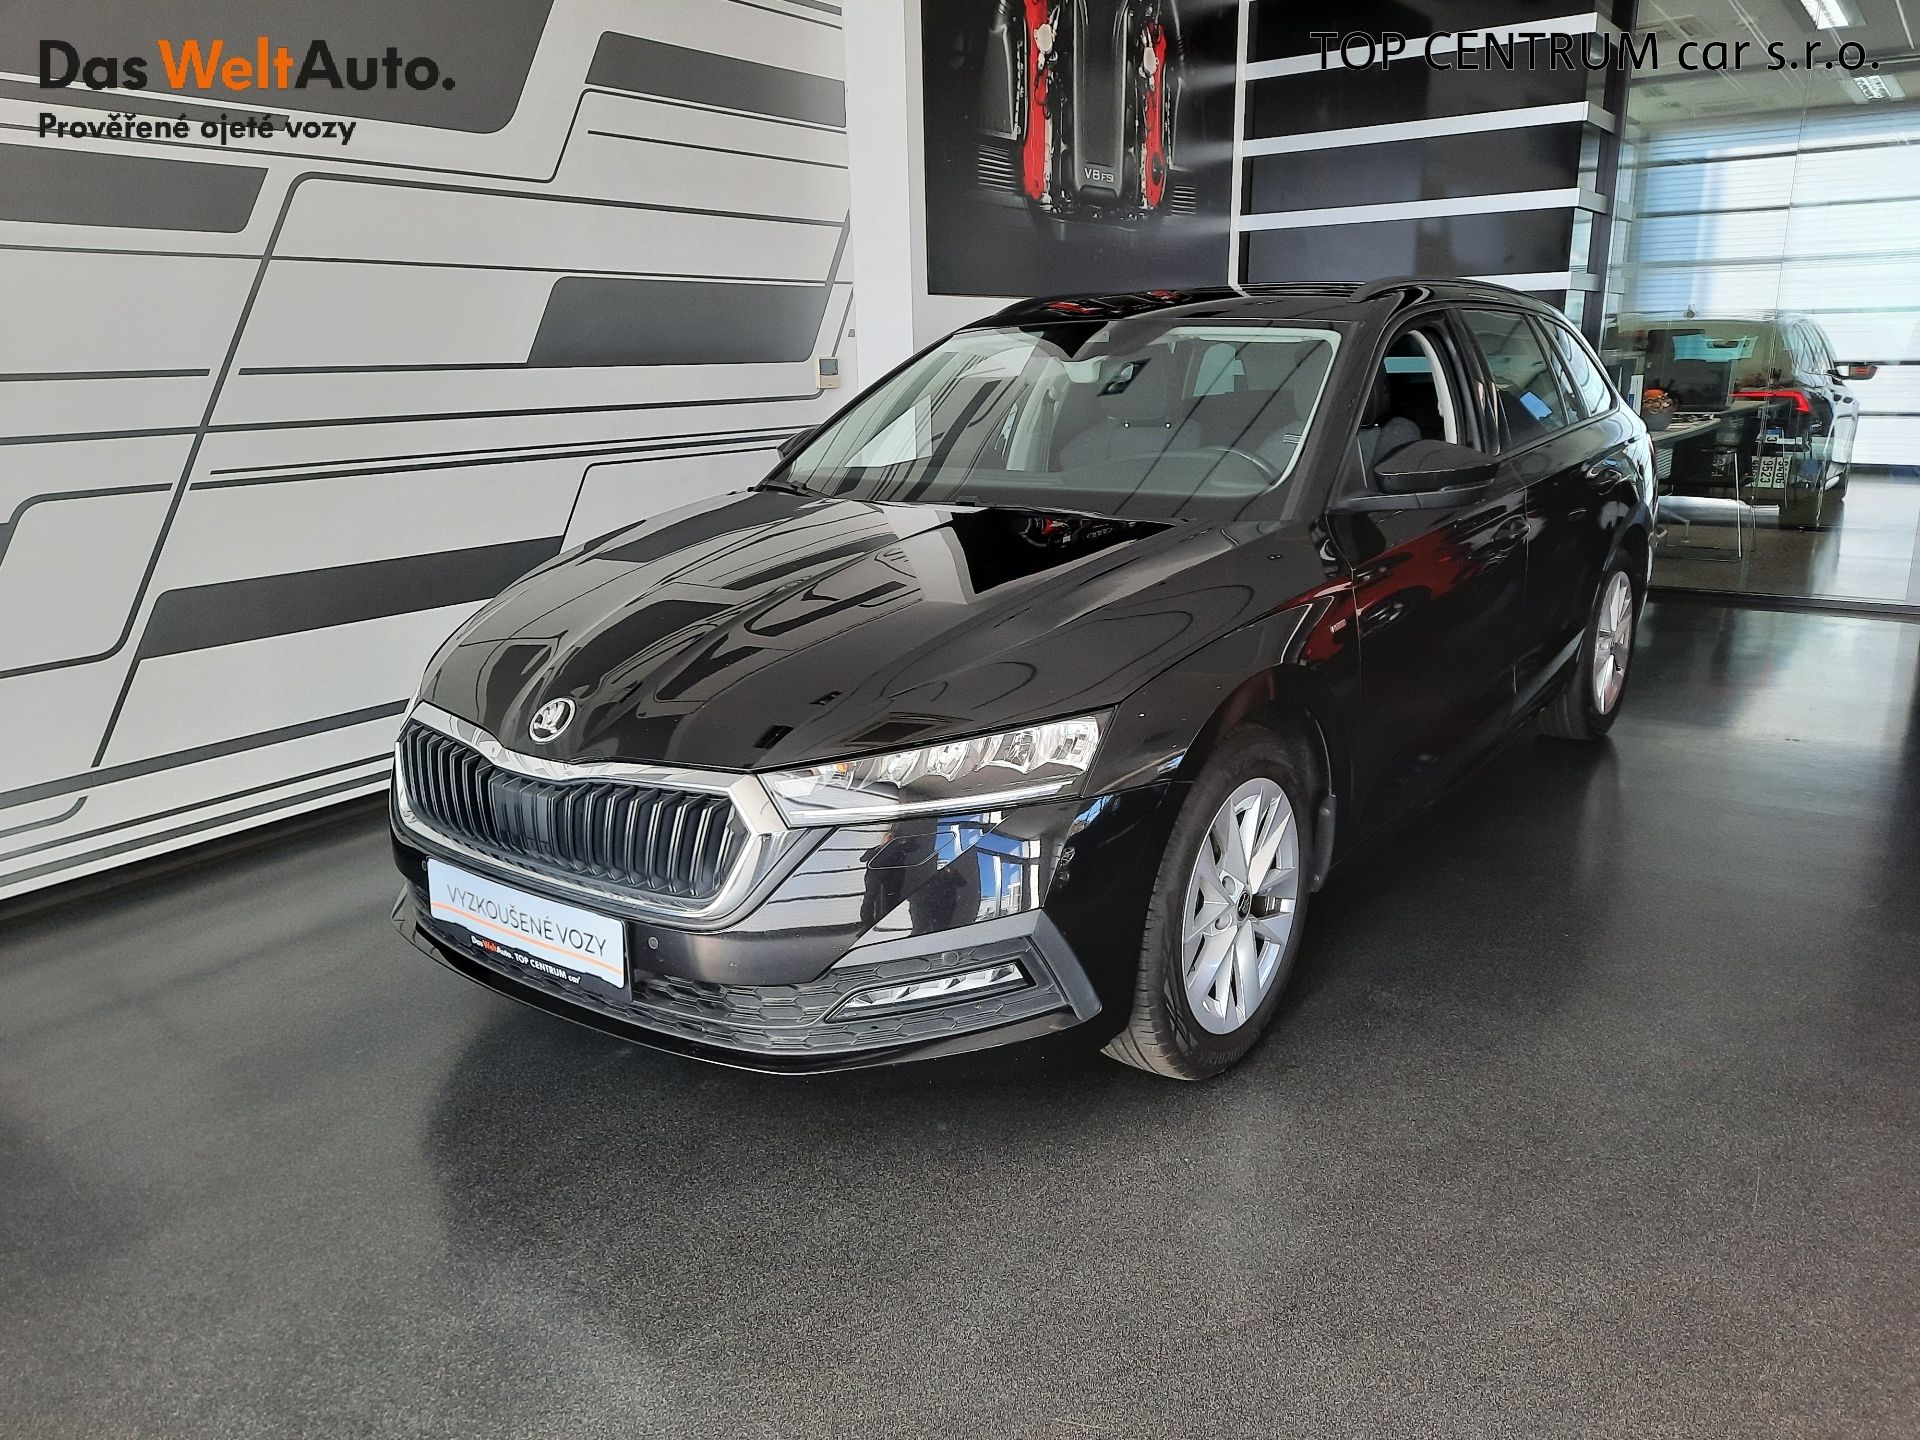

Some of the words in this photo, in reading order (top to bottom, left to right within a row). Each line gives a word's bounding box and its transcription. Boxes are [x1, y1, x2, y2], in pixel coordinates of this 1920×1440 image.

[1083, 167, 1100, 181] V8
[447, 883, 553, 941] VYZKOUŠENÉ
[555, 926, 607, 957] VOZY
[513, 952, 529, 965] TOP
[529, 959, 568, 980] CENTRUM
